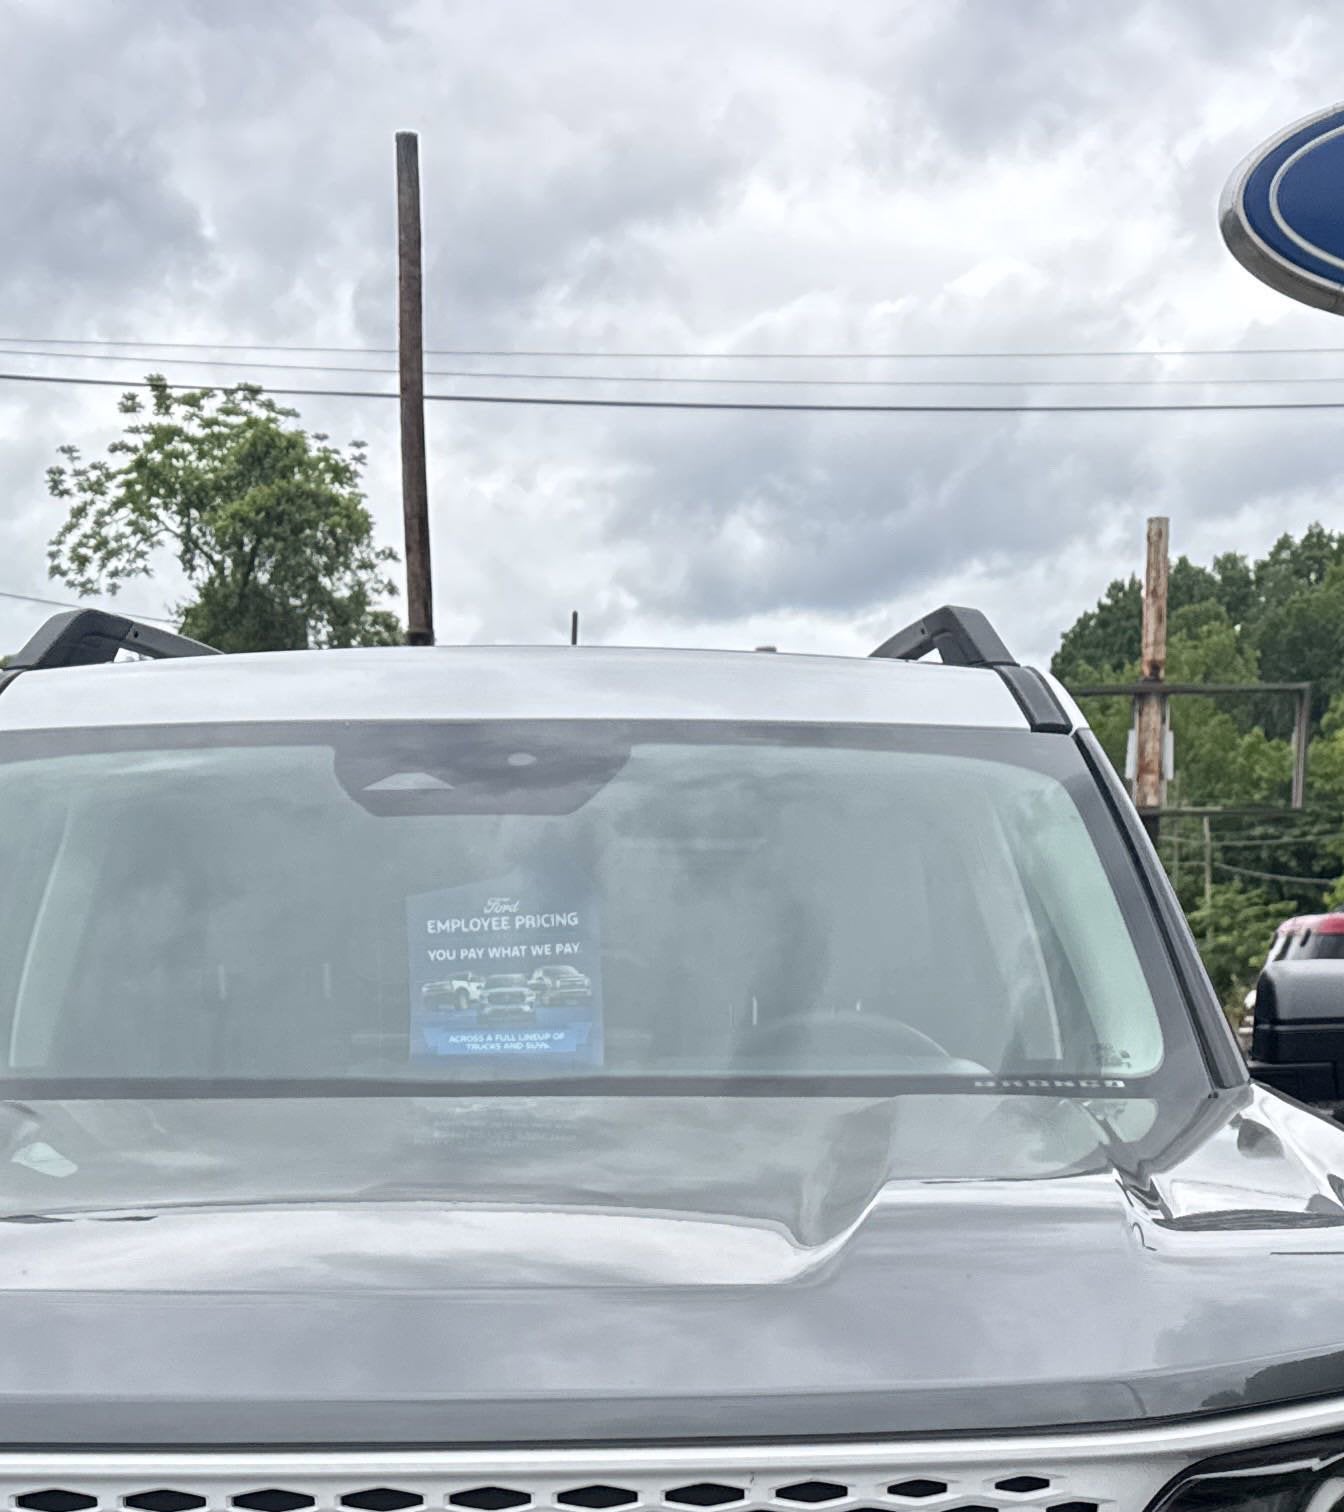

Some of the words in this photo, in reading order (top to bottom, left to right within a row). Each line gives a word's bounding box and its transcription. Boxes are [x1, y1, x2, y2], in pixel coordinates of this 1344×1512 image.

[484, 897, 520, 914] Ford
[426, 915, 511, 934] EMPLOYEE
[514, 911, 579, 929] PRICING
[427, 949, 456, 961] YOU
[460, 947, 484, 960] PAY
[488, 945, 527, 958] WHAT
[530, 943, 552, 956] WE
[555, 942, 581, 955] PAY
[448, 1034, 484, 1043] ACROSS
[486, 1033, 493, 1042] A
[495, 1033, 516, 1042] FULL
